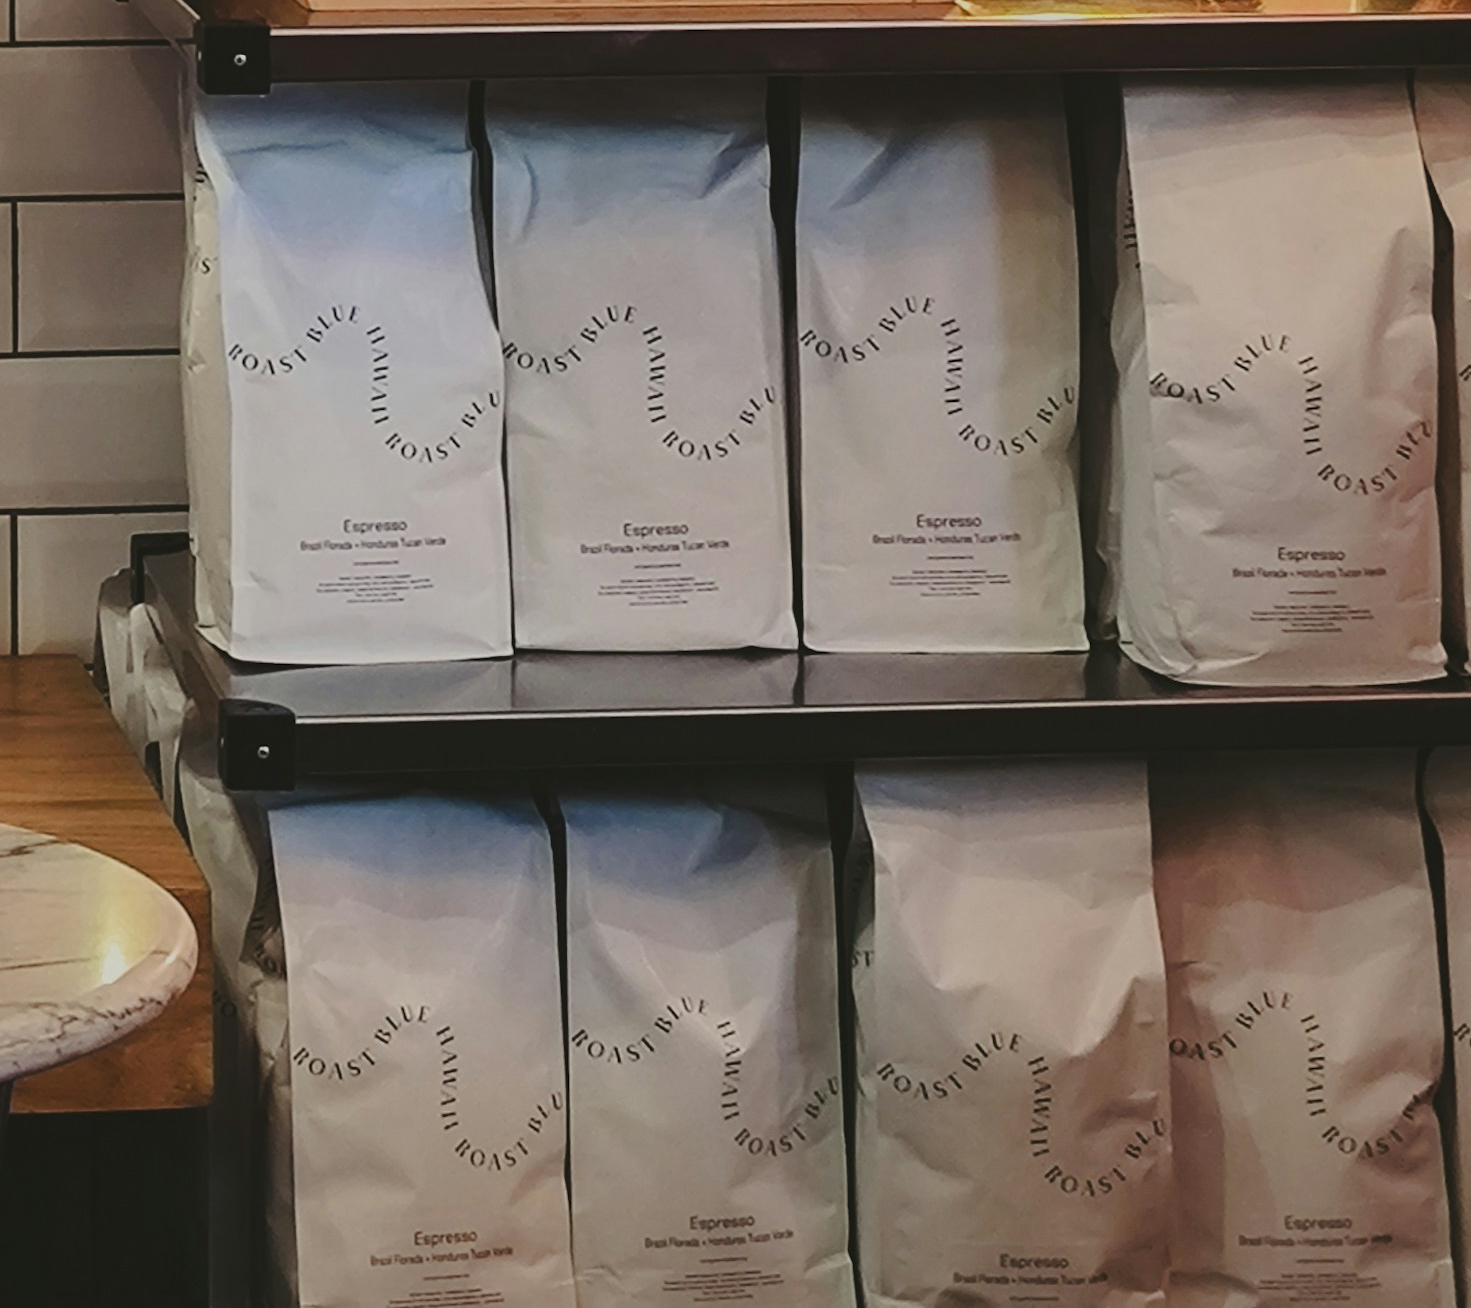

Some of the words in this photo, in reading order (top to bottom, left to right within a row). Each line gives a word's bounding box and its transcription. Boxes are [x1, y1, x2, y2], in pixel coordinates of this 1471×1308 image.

[228, 344, 308, 376] ROAST
[306, 306, 361, 344] BLUE
[366, 326, 389, 424] HAWAII
[384, 433, 462, 463] ROAST
[501, 342, 582, 375] ROAST
[580, 305, 637, 343] BLUE
[642, 326, 667, 423] HAWAII
[662, 430, 741, 462] ROAST
[799, 329, 880, 364] ROAST
[879, 297, 935, 333] BLUE
[940, 318, 964, 416] HAWAII
[958, 424, 1038, 457] ROAST
[1149, 371, 1236, 405] ROAST
[1234, 333, 1292, 373] BLUE
[1298, 355, 1323, 456] HAWAII
[1317, 464, 1399, 496] ROAST
[343, 519, 408, 534] Espresso
[623, 522, 689, 538] Espresso
[916, 514, 983, 530] Espresso
[1278, 546, 1346, 563] Espresso
[293, 1047, 376, 1081] ROAST
[374, 1004, 431, 1045] BLUE
[436, 1026, 459, 1131] HAWAII
[454, 1138, 529, 1172] ROAST
[571, 1029, 655, 1064] ROAST
[654, 996, 709, 1034] BLUE
[717, 1020, 742, 1121] HAWAII
[734, 1123, 806, 1157] ROAST
[876, 1062, 963, 1101] ROAST
[961, 1032, 1022, 1072] BLUE
[1028, 1056, 1053, 1157] HAWAII
[1043, 1164, 1126, 1198] ROAST
[1168, 1030, 1239, 1061] OAST
[1235, 991, 1293, 1030] BLUE
[1300, 1014, 1326, 1117] HAWAII
[1322, 1125, 1404, 1159] ROAST
[414, 1231, 478, 1248] Espresso
[689, 1215, 756, 1233] Espresso
[999, 1253, 1070, 1270] Espresso
[1284, 1214, 1353, 1232] Espresso
